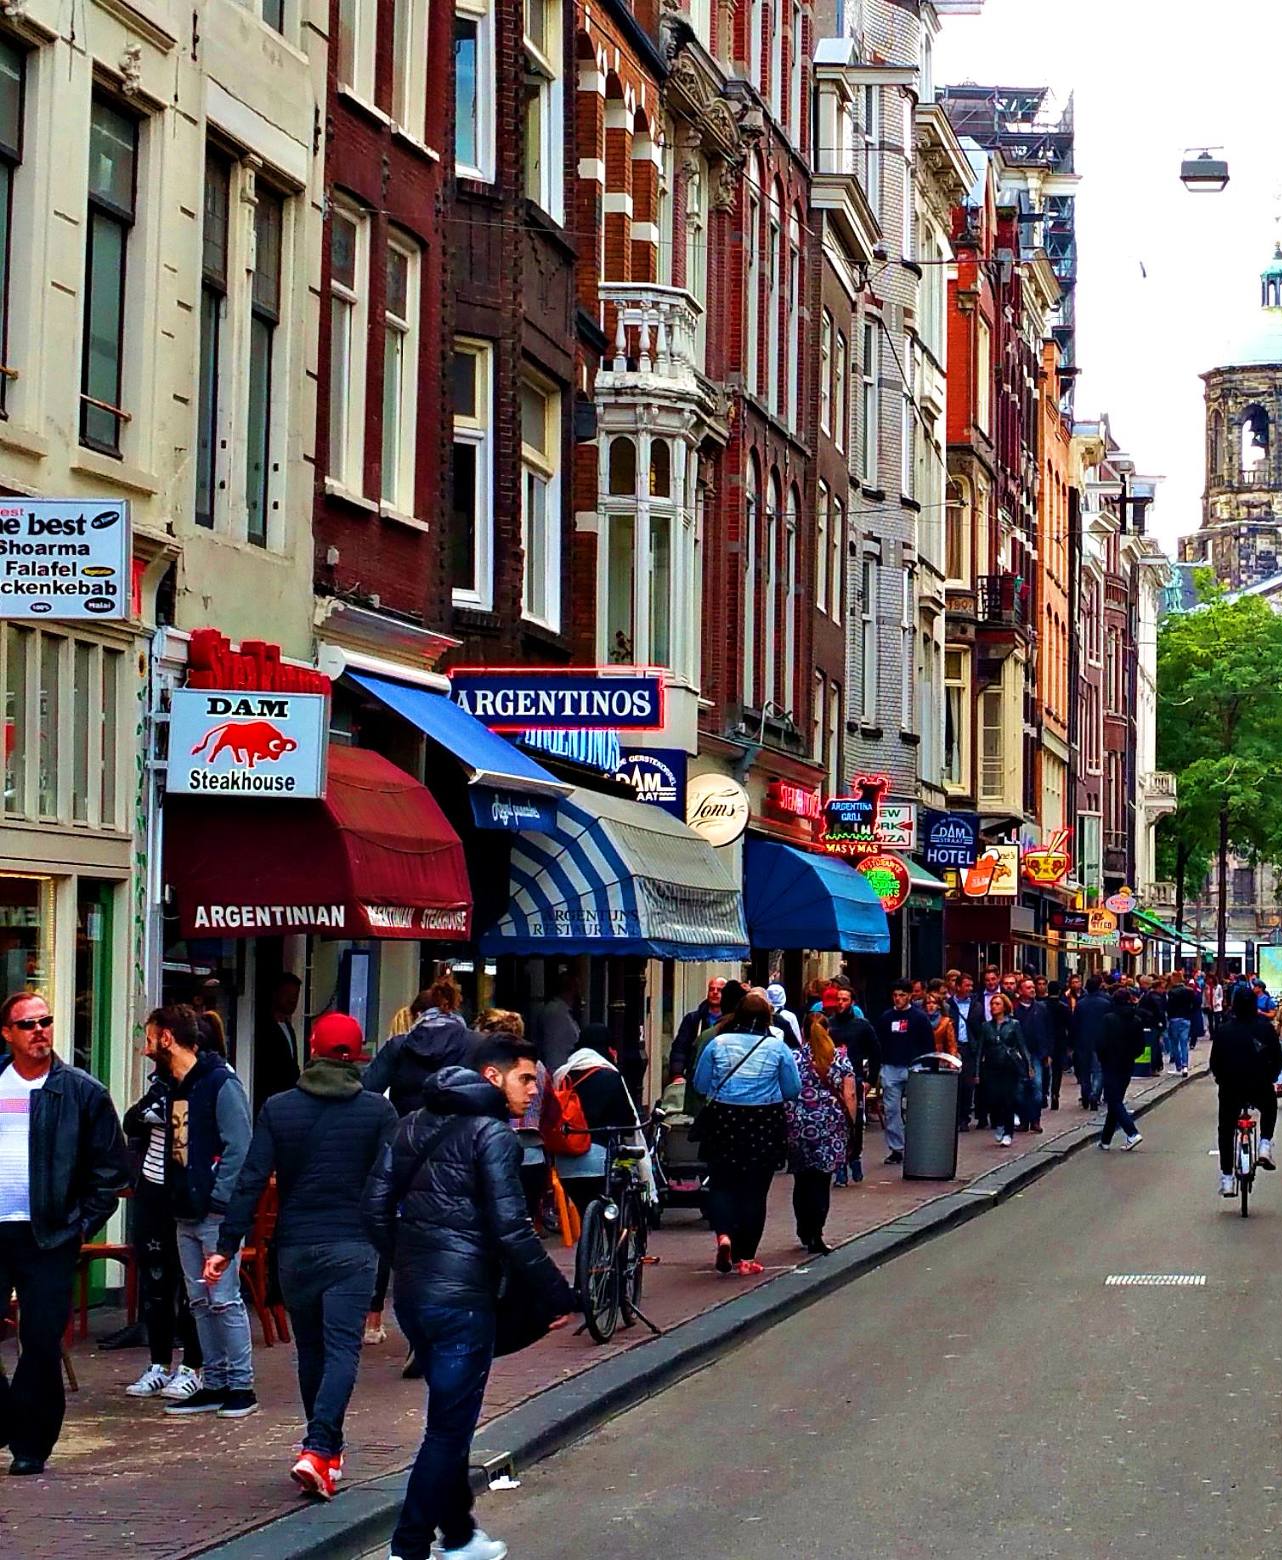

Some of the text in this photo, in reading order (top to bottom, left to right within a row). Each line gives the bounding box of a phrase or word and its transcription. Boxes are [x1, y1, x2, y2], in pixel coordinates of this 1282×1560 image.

[27, 513, 87, 536] best
[0, 540, 90, 556] Shoarma
[6, 561, 77, 577] Falafel
[0, 580, 117, 596] ckenkebab
[207, 698, 288, 717] DAM
[457, 689, 651, 717] ARGENTINOS
[190, 770, 295, 791] Steakhouse
[940, 823, 966, 839] DAM
[826, 844, 847, 854] MAS
[857, 844, 879, 854] MAS
[927, 848, 975, 865] HOTEL
[194, 906, 345, 928] ARGENTINIAN
